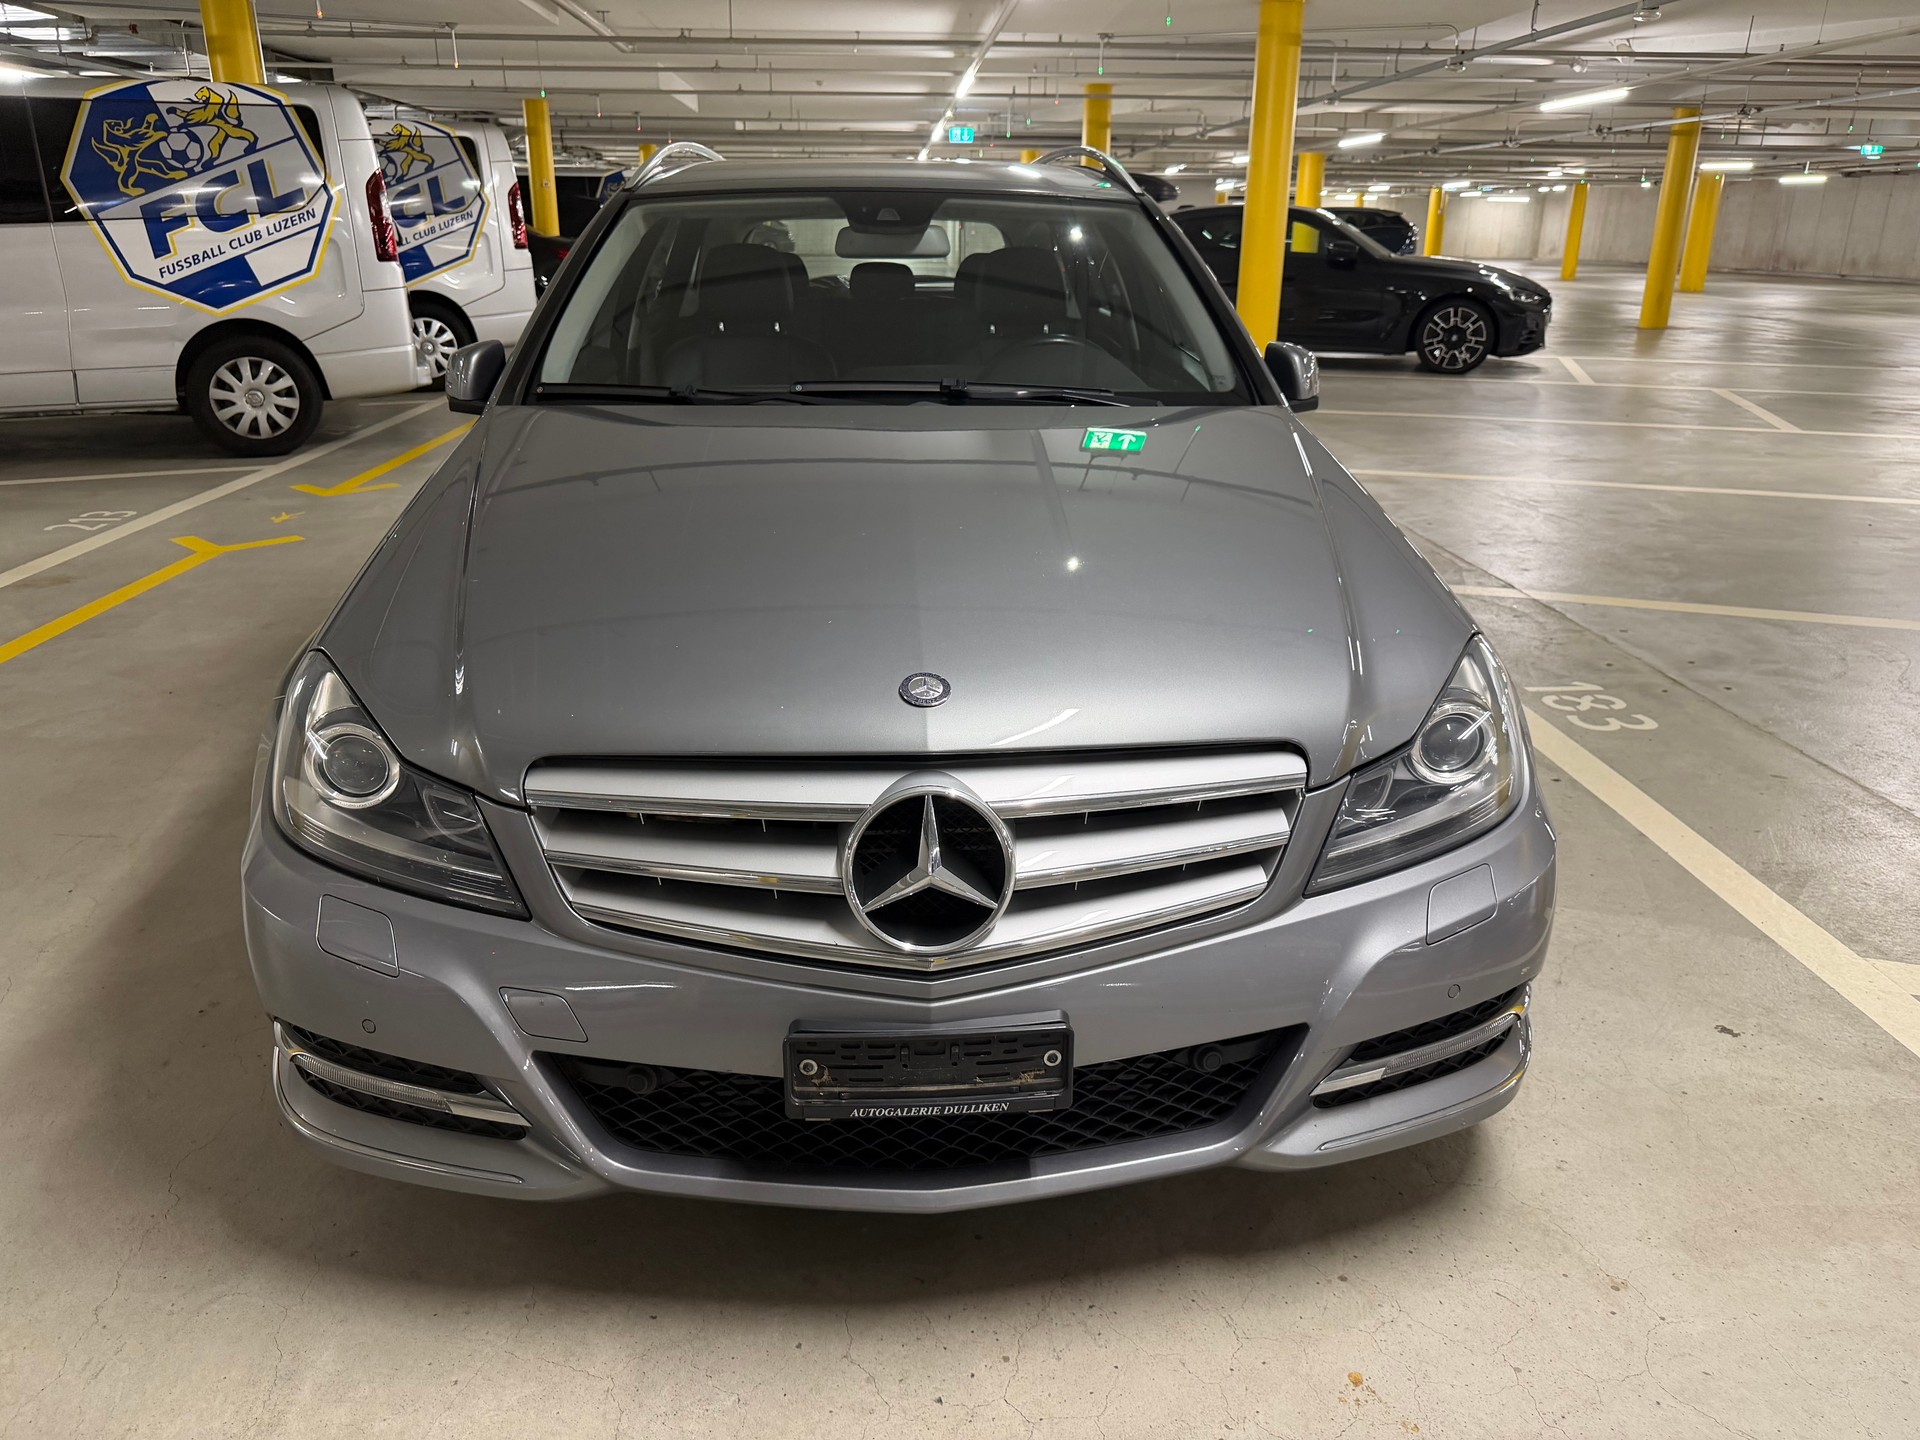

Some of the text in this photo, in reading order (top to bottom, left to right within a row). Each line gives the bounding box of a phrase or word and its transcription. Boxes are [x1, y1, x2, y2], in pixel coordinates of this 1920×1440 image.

[140, 158, 308, 260] FCL
[390, 175, 468, 228] CL
[412, 225, 437, 241] CLUB
[439, 210, 474, 231] LUZERN
[158, 208, 317, 279] FUSSBALL CLUB LUZERN
[1523, 681, 1659, 731] 183
[850, 1102, 1010, 1117] AUTOGALERIE DULLIKEN
